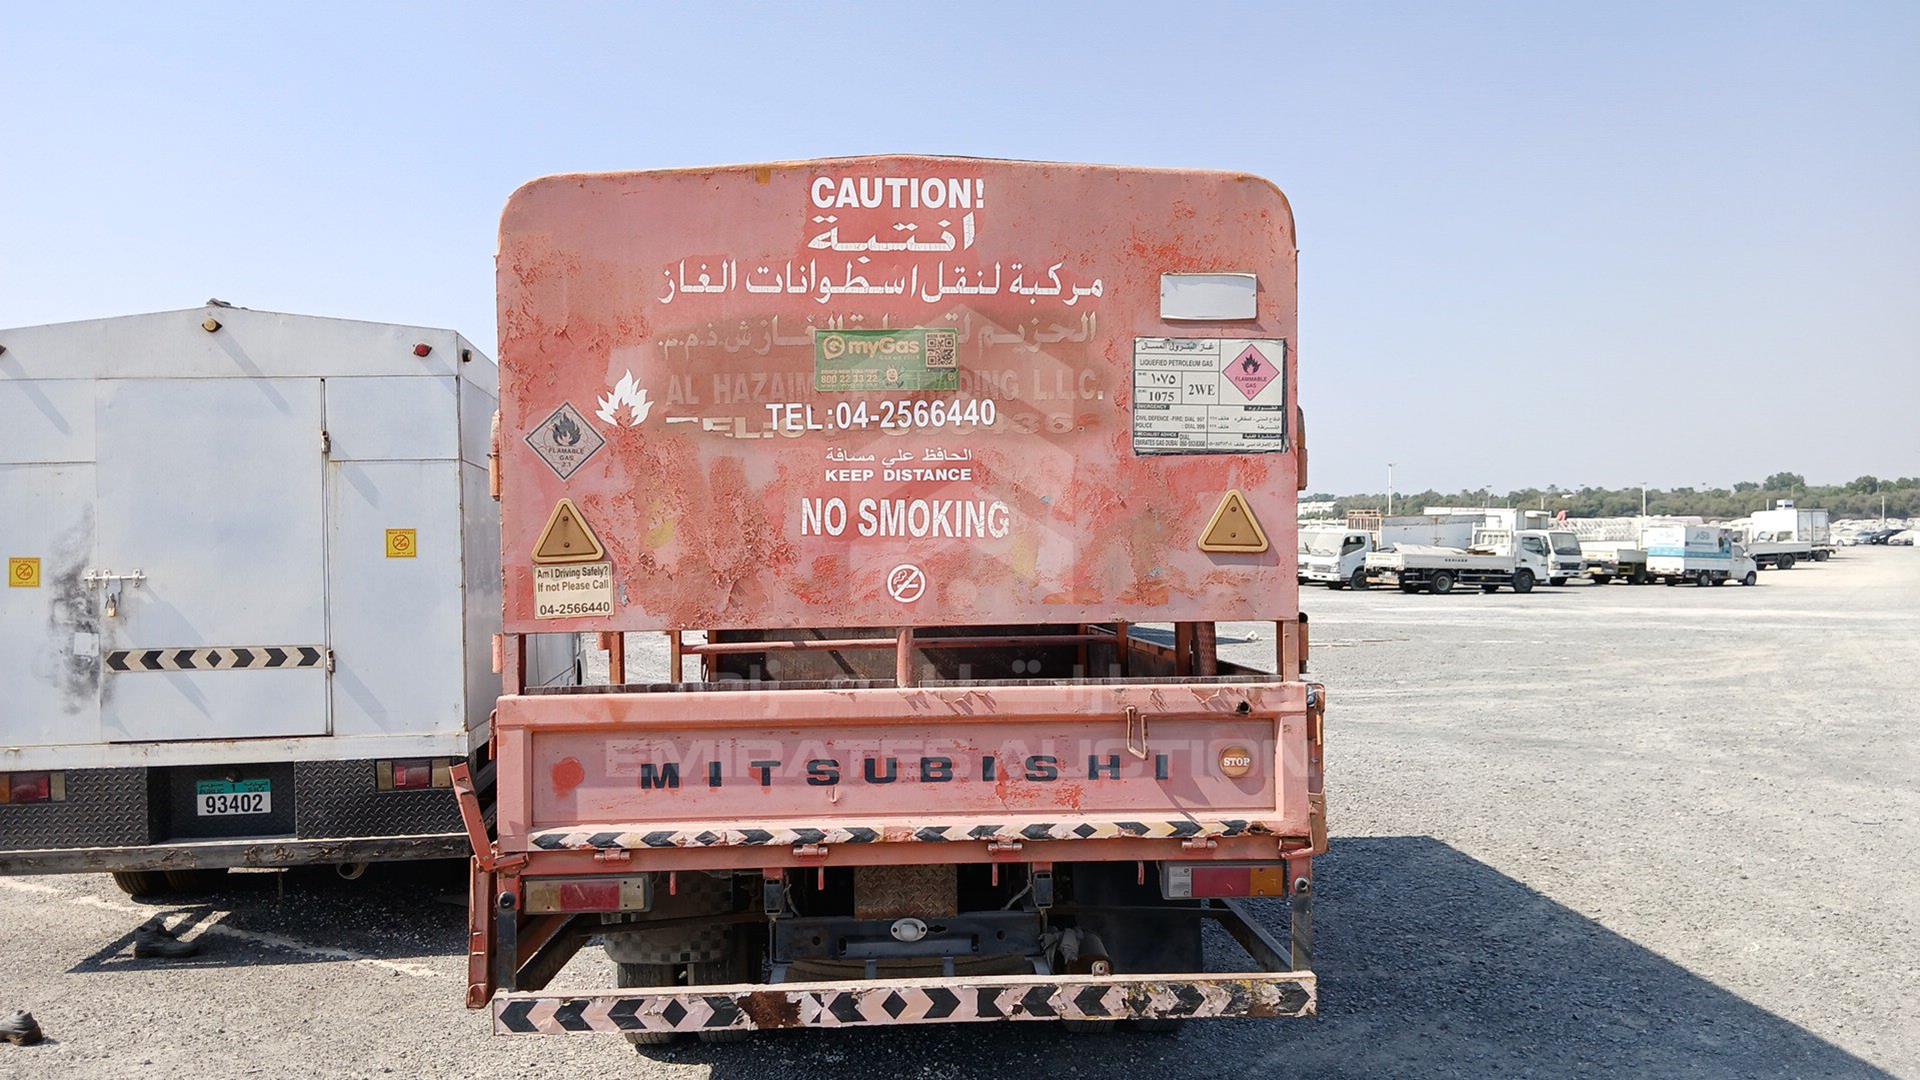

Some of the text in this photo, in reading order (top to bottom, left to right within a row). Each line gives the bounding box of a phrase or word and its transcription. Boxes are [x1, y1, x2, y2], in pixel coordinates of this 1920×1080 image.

[811, 176, 985, 209] CAUTION!
[657, 259, 1104, 306] مركبة لنقل اسطوانات الغاز
[848, 337, 920, 358] myGas
[1139, 359, 1168, 367] LIQUEFIED
[1168, 359, 1201, 367] PETROLEUM
[821, 374, 837, 384] 800
[1150, 391, 1175, 402] 1075
[1188, 384, 1215, 396] 2WE
[765, 399, 996, 431] TEL:04-2566440
[825, 447, 874, 462] مسافة
[825, 468, 972, 482] KEEP DISTANCE
[800, 497, 1010, 539] NO SMOKING
[537, 569, 550, 579] Am
[554, 568, 580, 580] Driving
[582, 565, 609, 578] Safely?
[537, 579, 609, 592] If not Please Call
[540, 601, 610, 615] 04-2566440
[1223, 757, 1250, 767] STOP
[640, 754, 1169, 789] MITSUBISHI
[206, 794, 263, 814] 93402
